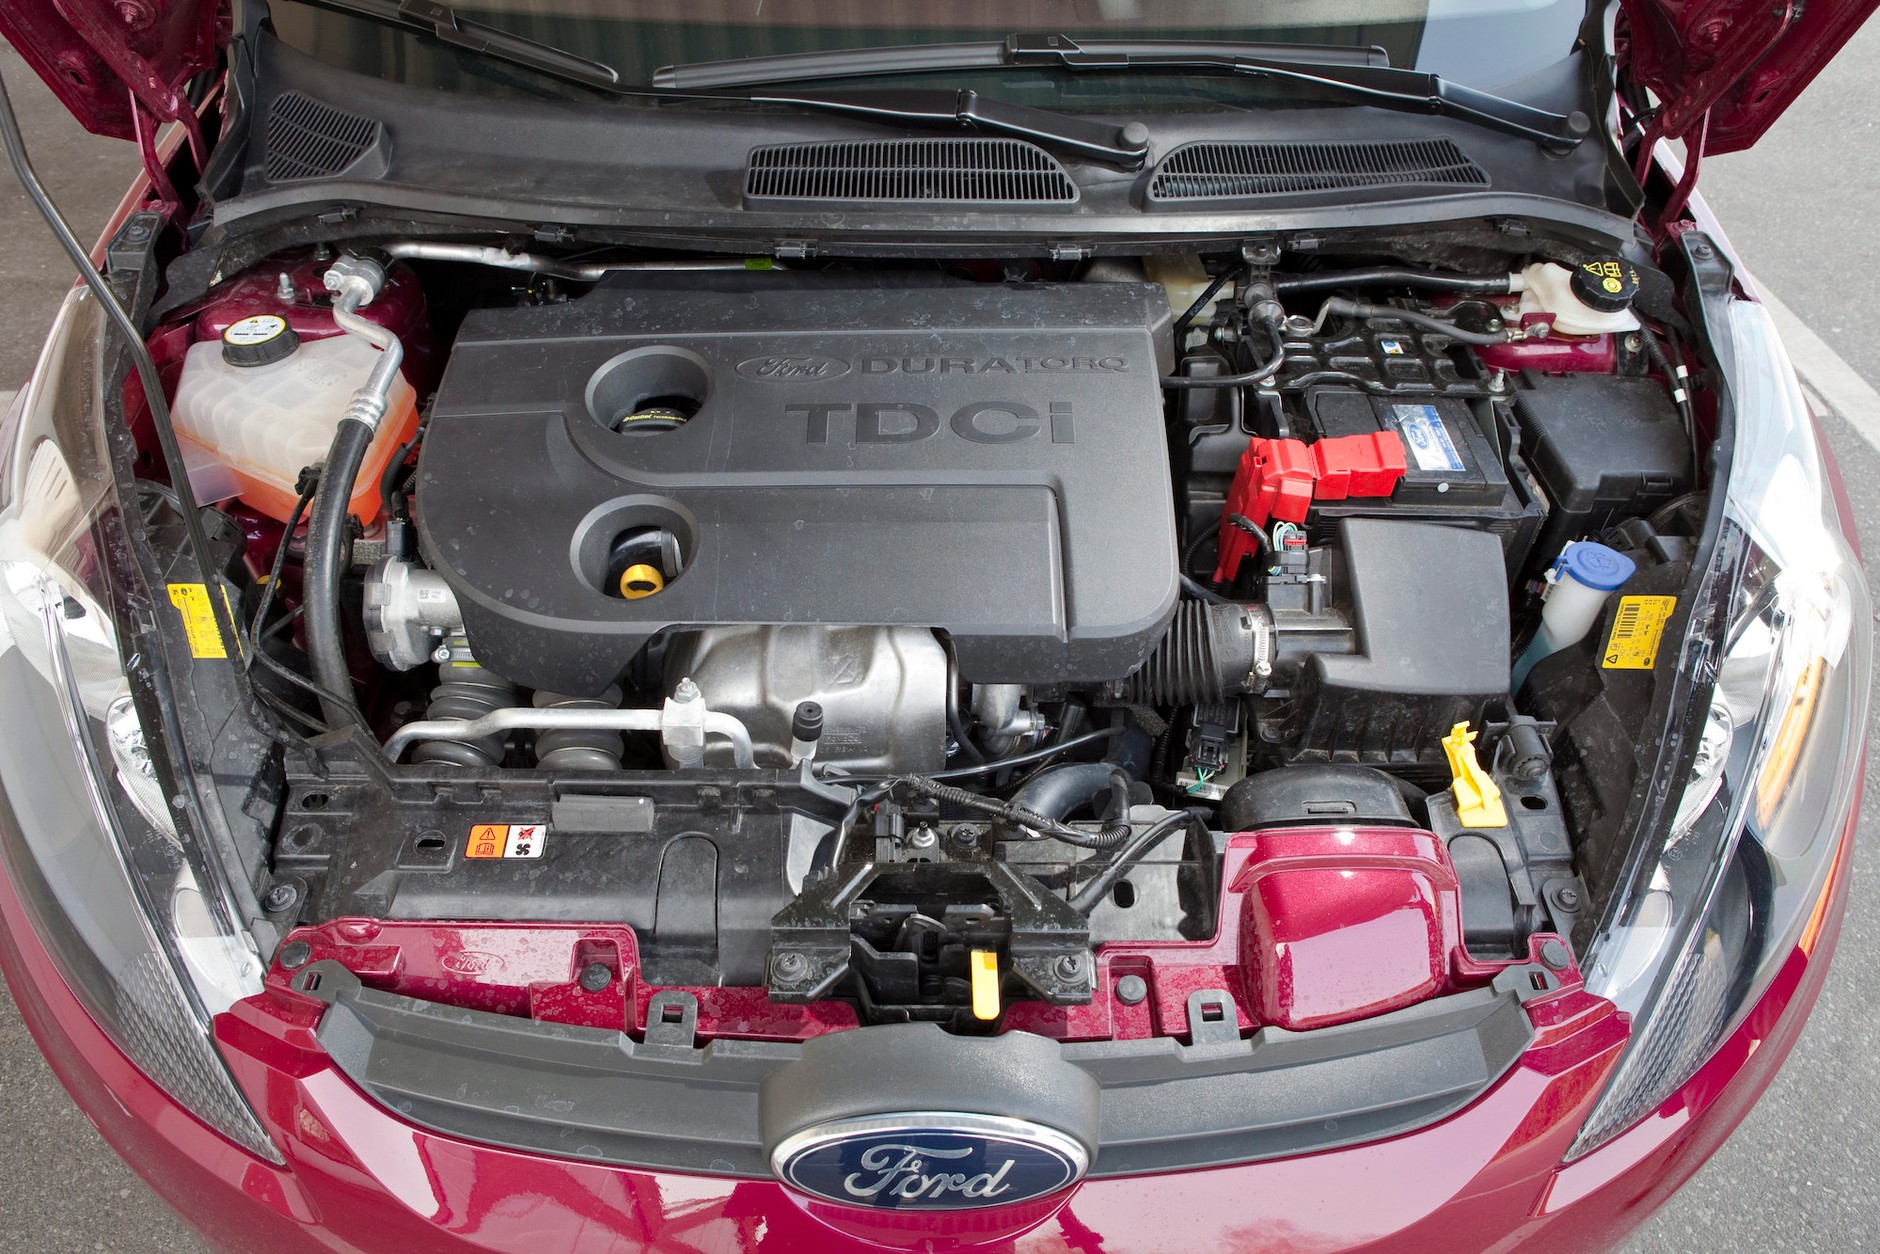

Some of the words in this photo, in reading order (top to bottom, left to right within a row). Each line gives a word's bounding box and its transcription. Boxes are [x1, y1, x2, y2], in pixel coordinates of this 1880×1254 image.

[757, 357, 828, 377] Ford
[862, 356, 1130, 375] DURATORQ
[785, 401, 1076, 444] TDCi
[455, 953, 490, 971] Ford
[844, 1144, 1015, 1198] Ford
